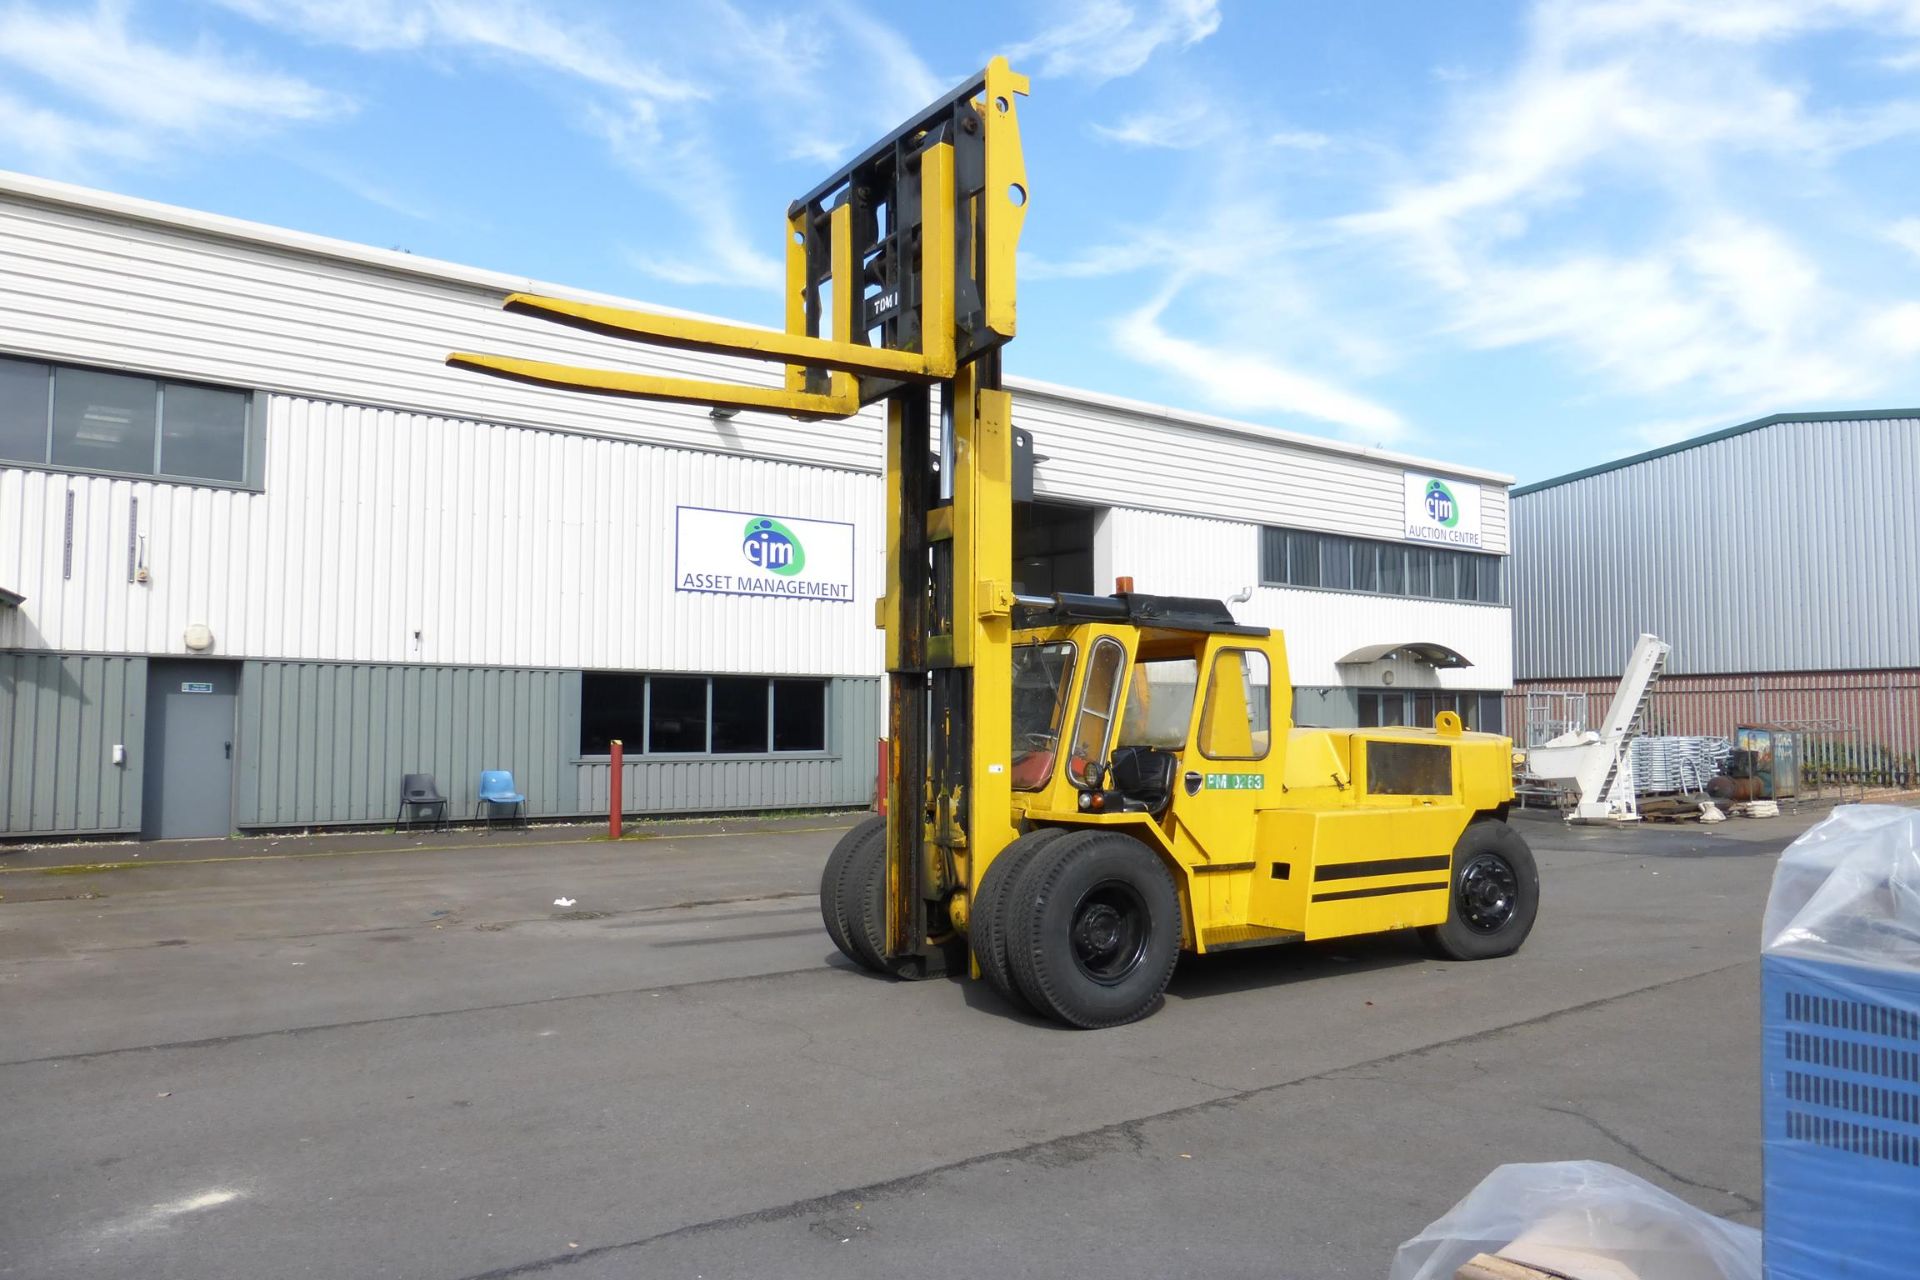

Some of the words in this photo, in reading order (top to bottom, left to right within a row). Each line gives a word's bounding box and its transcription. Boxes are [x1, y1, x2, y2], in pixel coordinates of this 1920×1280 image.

[1425, 492, 1453, 523] cjm
[1409, 525, 1447, 541] AUCTION
[1448, 530, 1479, 545] CENTRE
[744, 533, 794, 571] cjm
[683, 573, 732, 590] ASSET
[737, 576, 849, 598] MANAGEMENT
